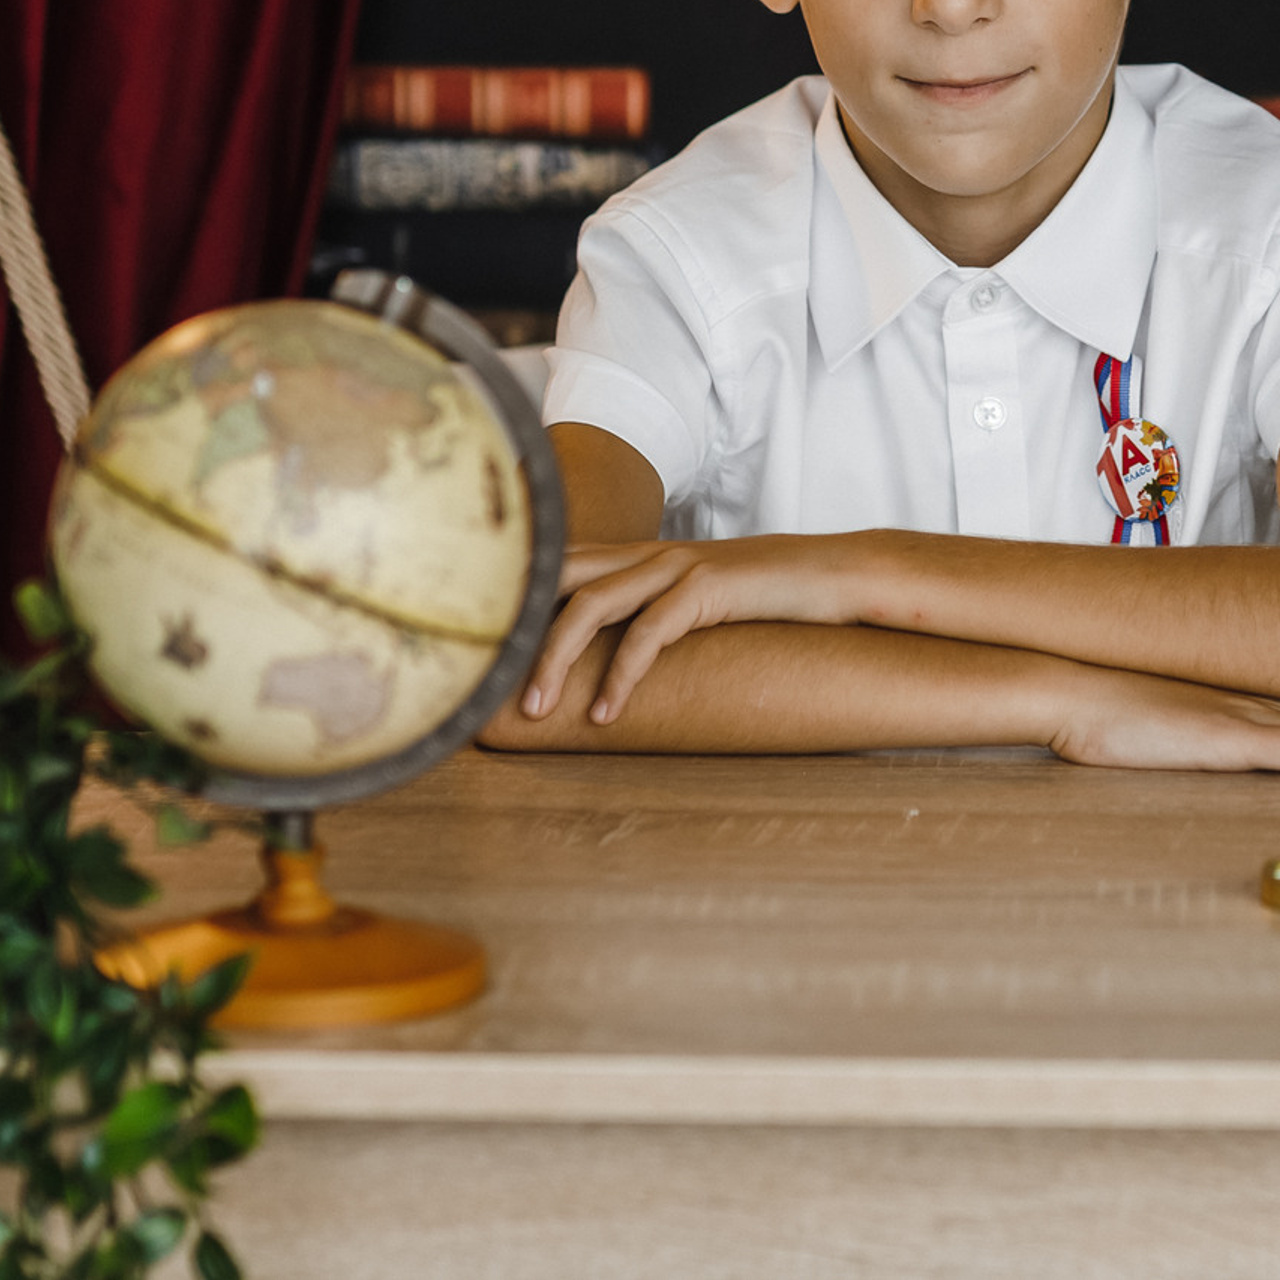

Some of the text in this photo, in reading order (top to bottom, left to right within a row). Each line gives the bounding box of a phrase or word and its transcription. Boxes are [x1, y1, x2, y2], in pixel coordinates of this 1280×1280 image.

[1096, 434, 1150, 519] 1 А
[1123, 464, 1152, 484] КЛАСС
